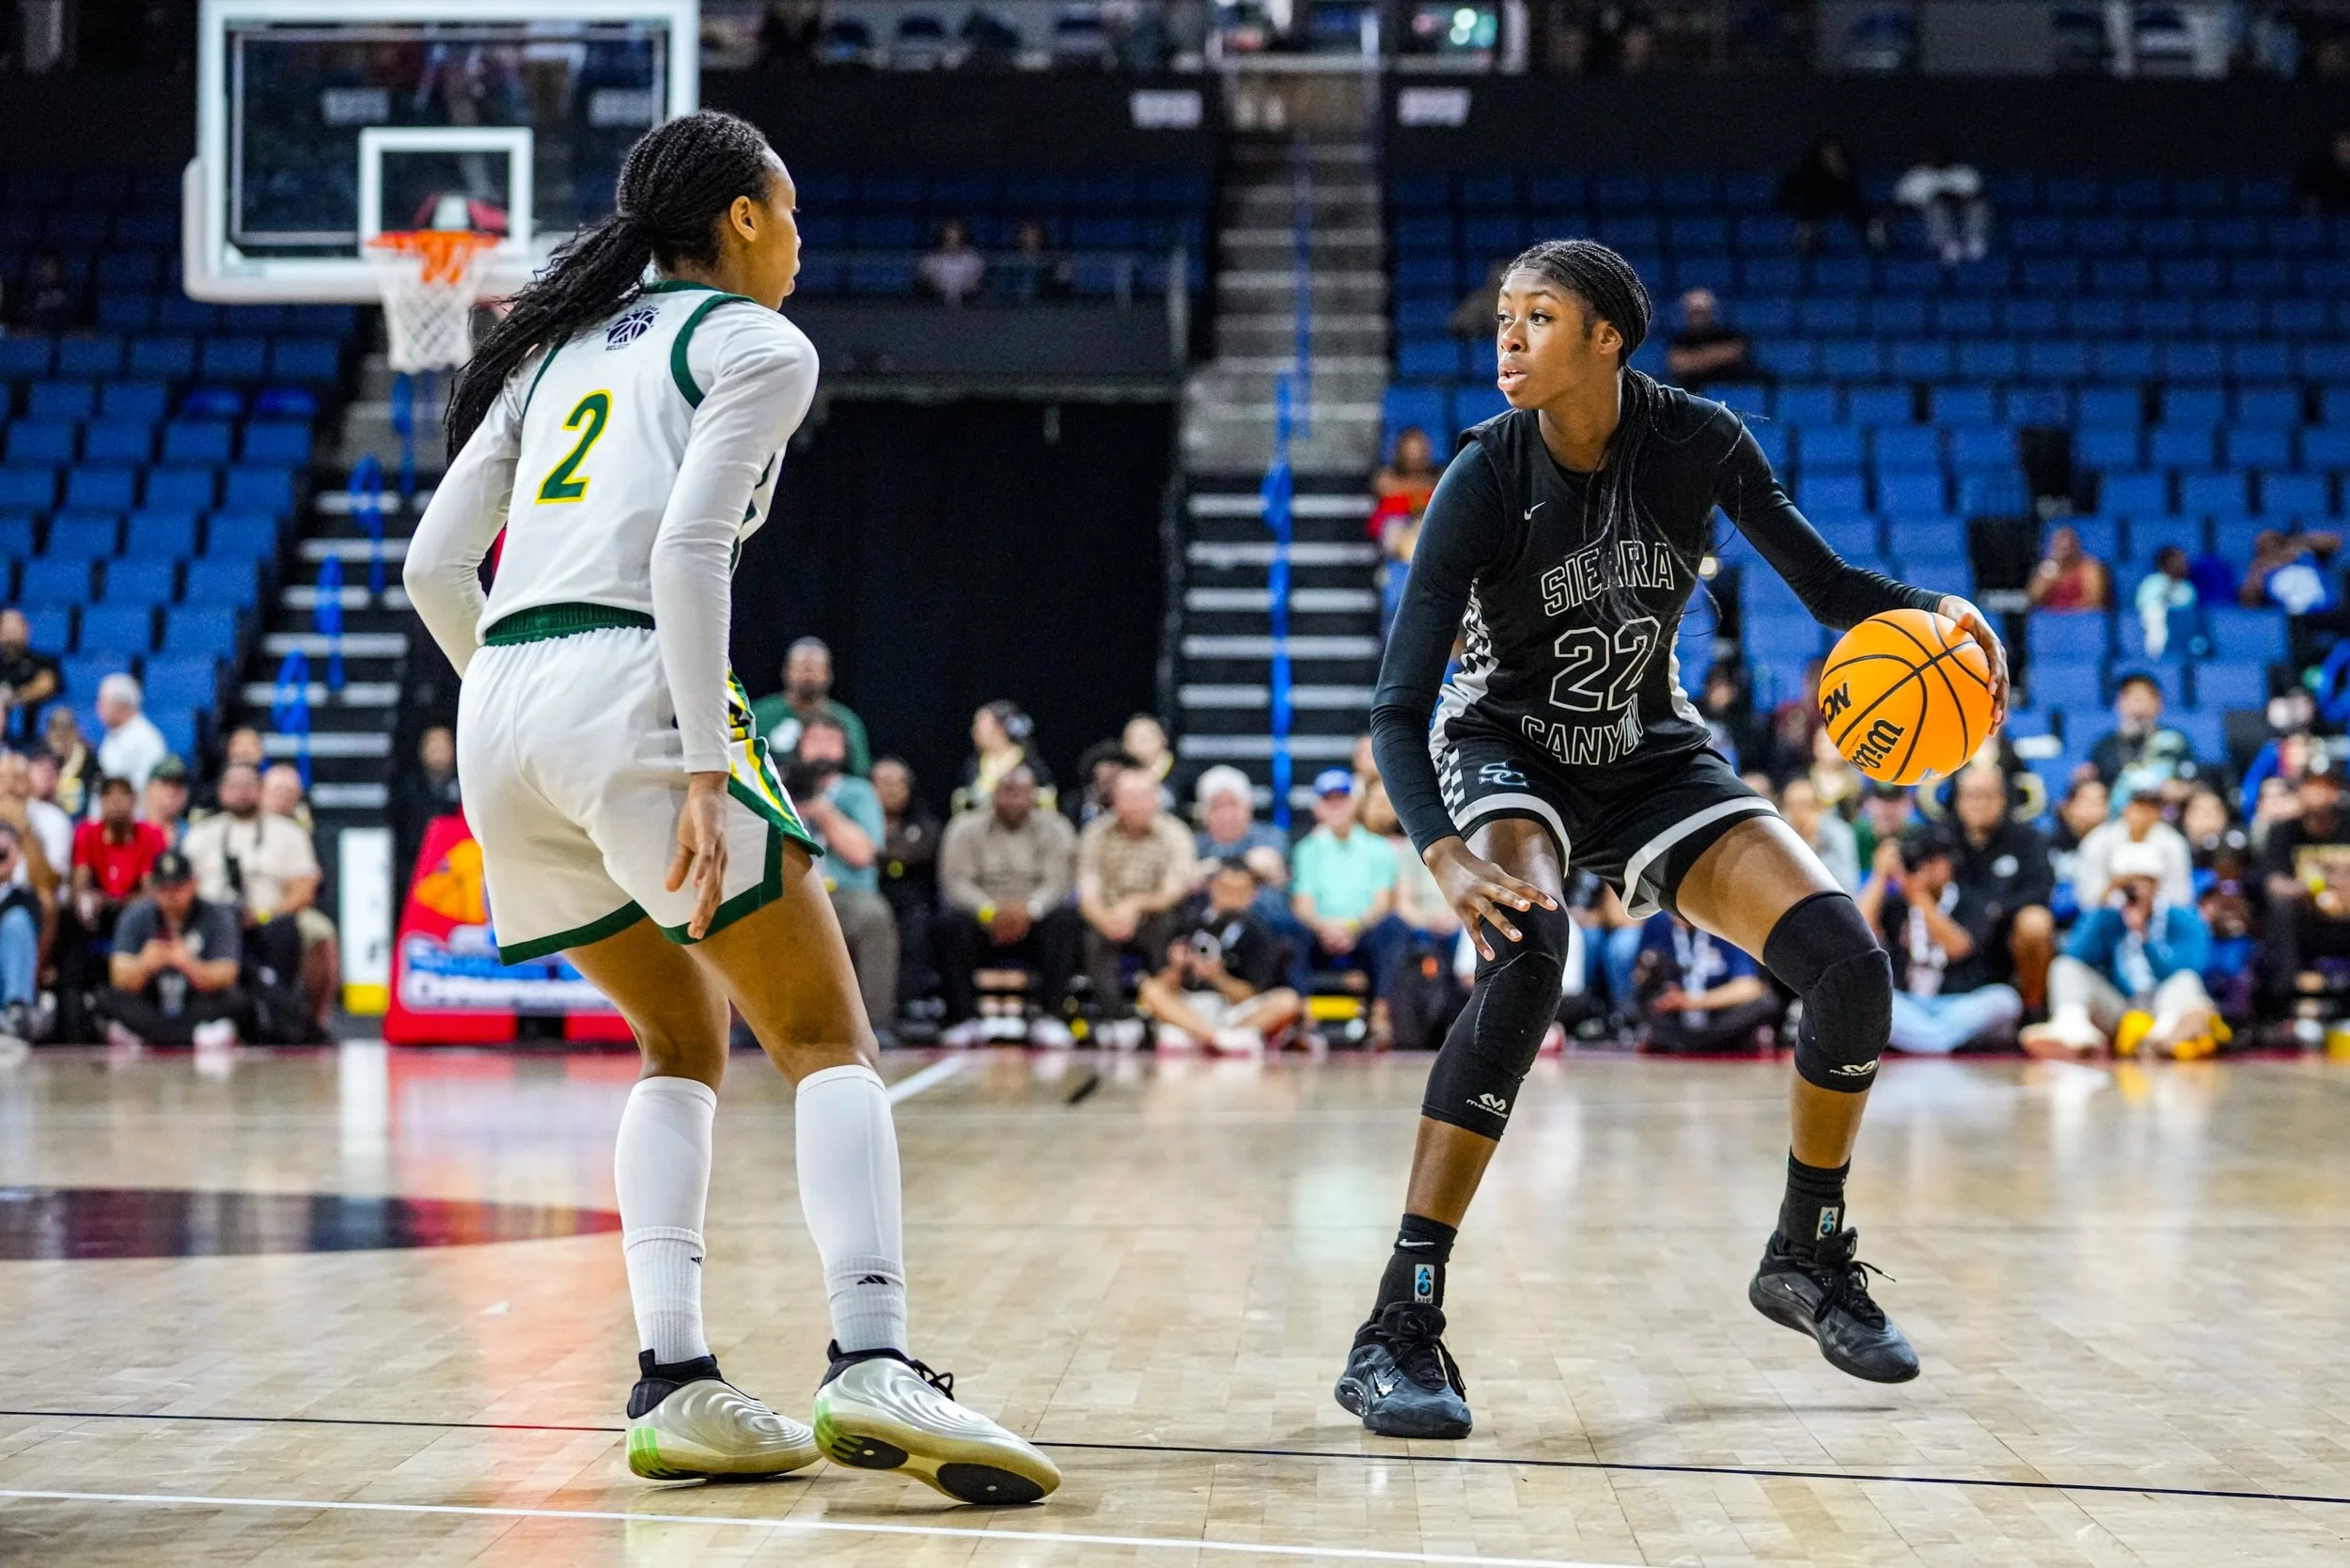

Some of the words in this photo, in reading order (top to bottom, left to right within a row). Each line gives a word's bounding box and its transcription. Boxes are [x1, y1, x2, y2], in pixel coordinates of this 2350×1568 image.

[535, 388, 613, 504] 2
[1541, 540, 1674, 617] SIERRA
[1548, 616, 1661, 713] 22
[1521, 693, 1643, 765] CANYON
[1821, 682, 1851, 730] NC
